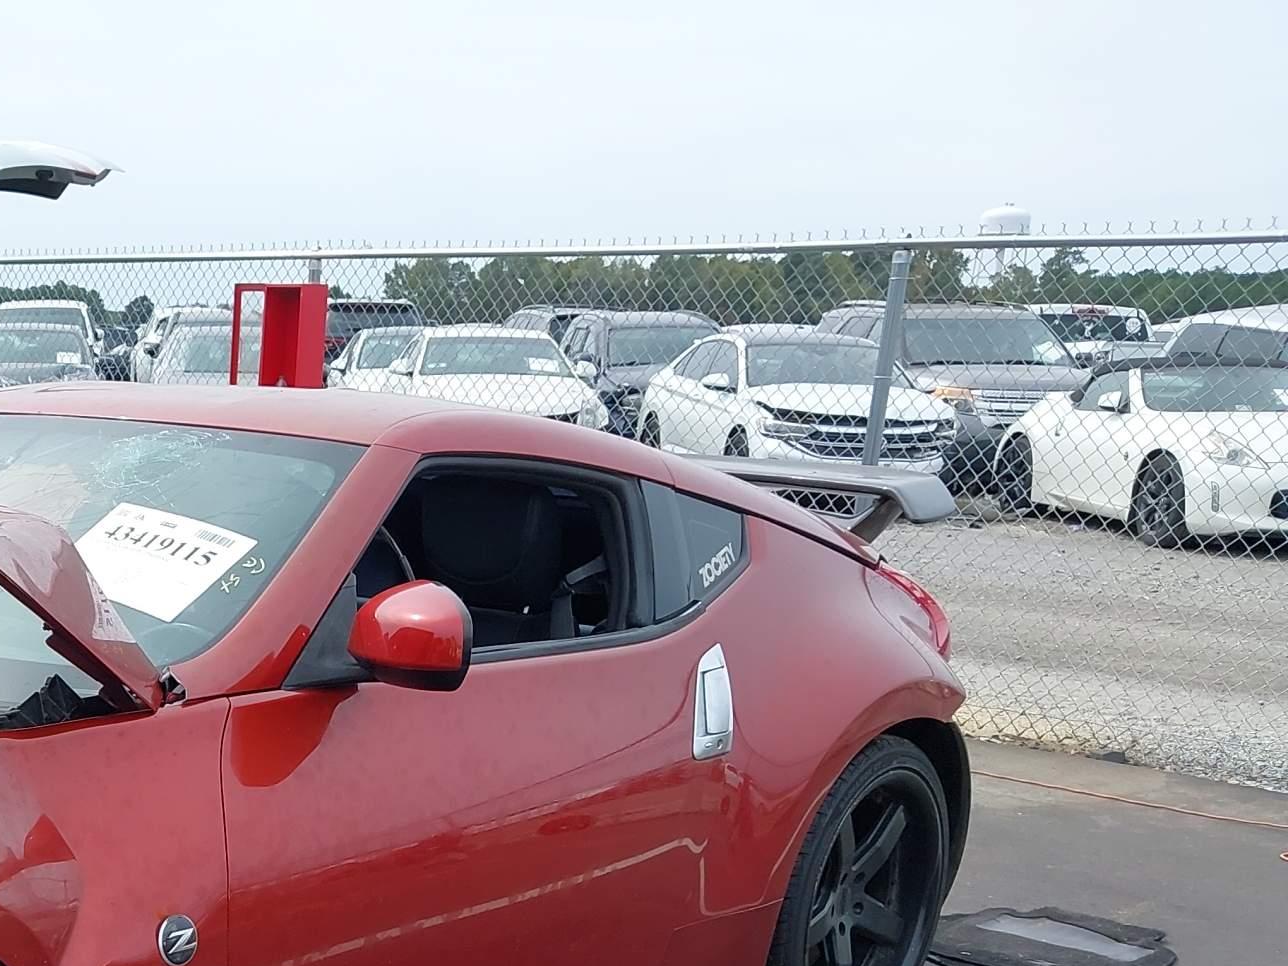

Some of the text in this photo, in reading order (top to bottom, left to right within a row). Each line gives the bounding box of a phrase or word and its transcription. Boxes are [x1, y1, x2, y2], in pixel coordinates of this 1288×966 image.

[104, 524, 218, 566] 43419115
[698, 542, 736, 588] ZOCIETY
[167, 927, 198, 955] Z
